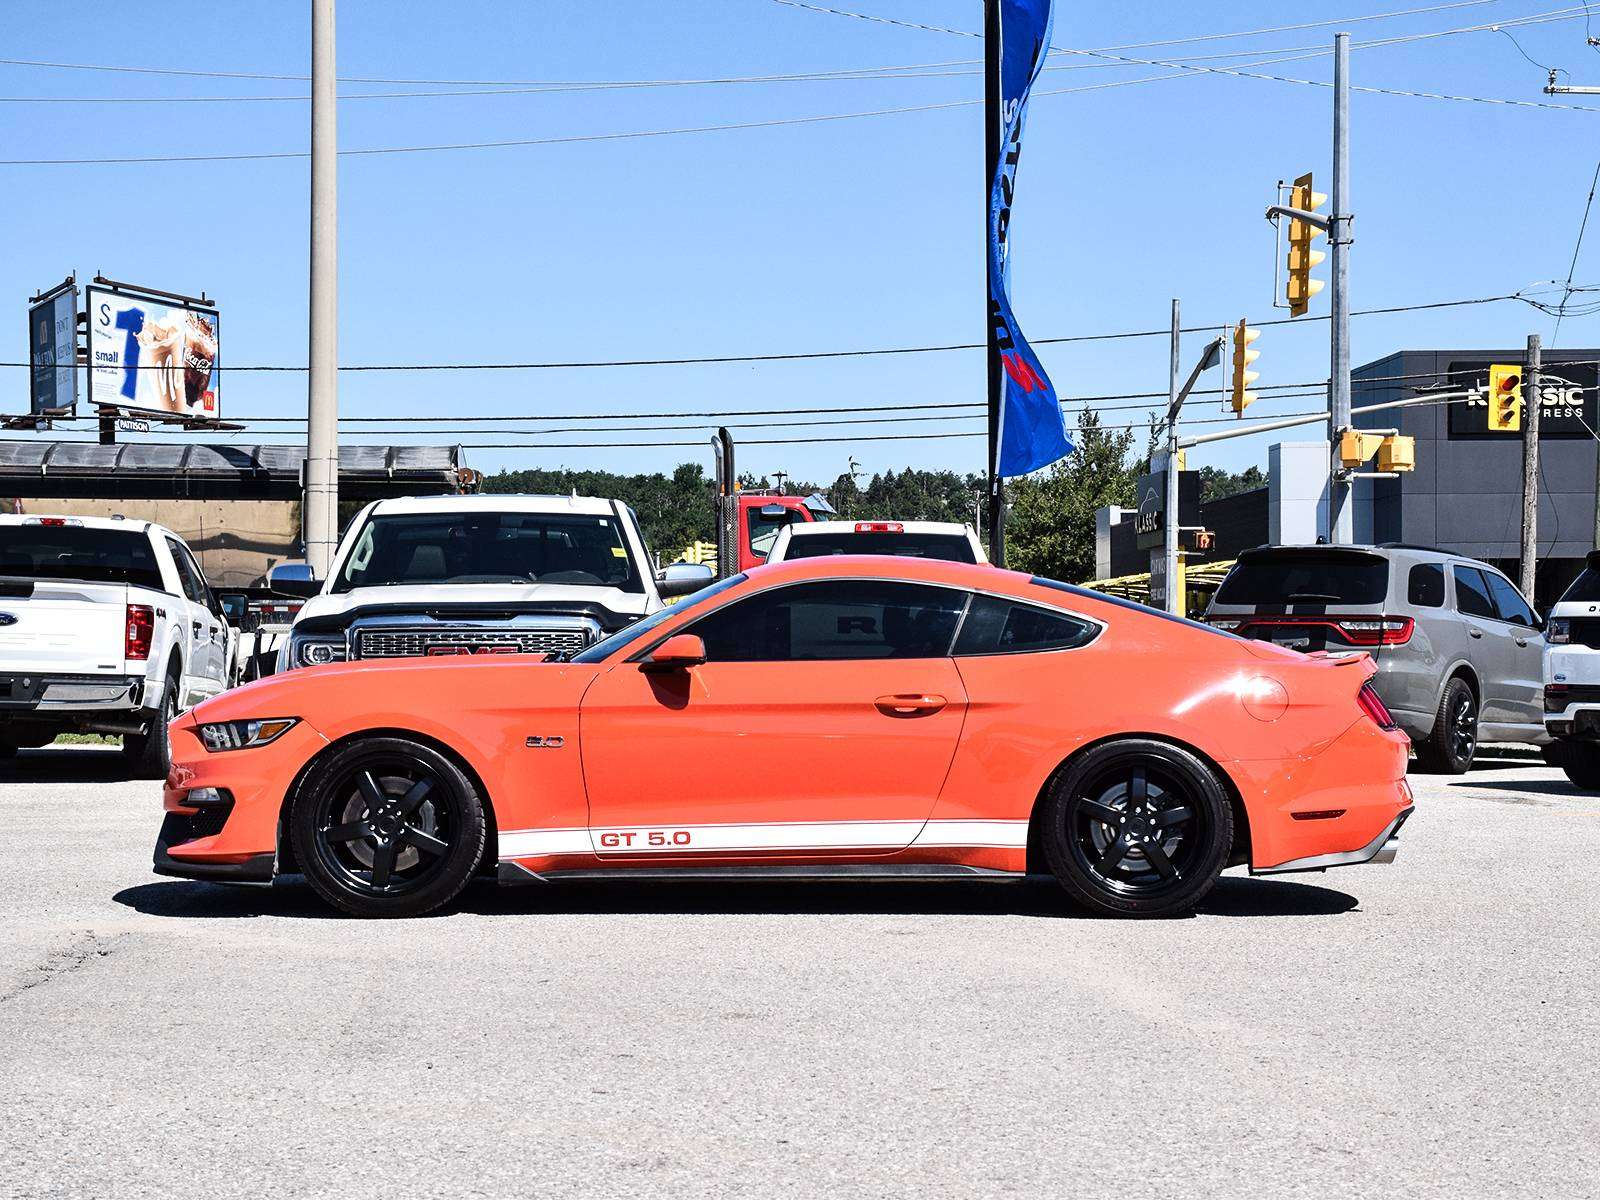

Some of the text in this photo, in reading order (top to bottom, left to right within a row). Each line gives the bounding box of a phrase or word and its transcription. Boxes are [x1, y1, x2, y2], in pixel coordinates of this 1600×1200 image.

[95, 351, 119, 363] small
[120, 420, 148, 432] PATTISON
[526, 736, 565, 748] 5.0
[600, 831, 691, 847] GT 5.0
